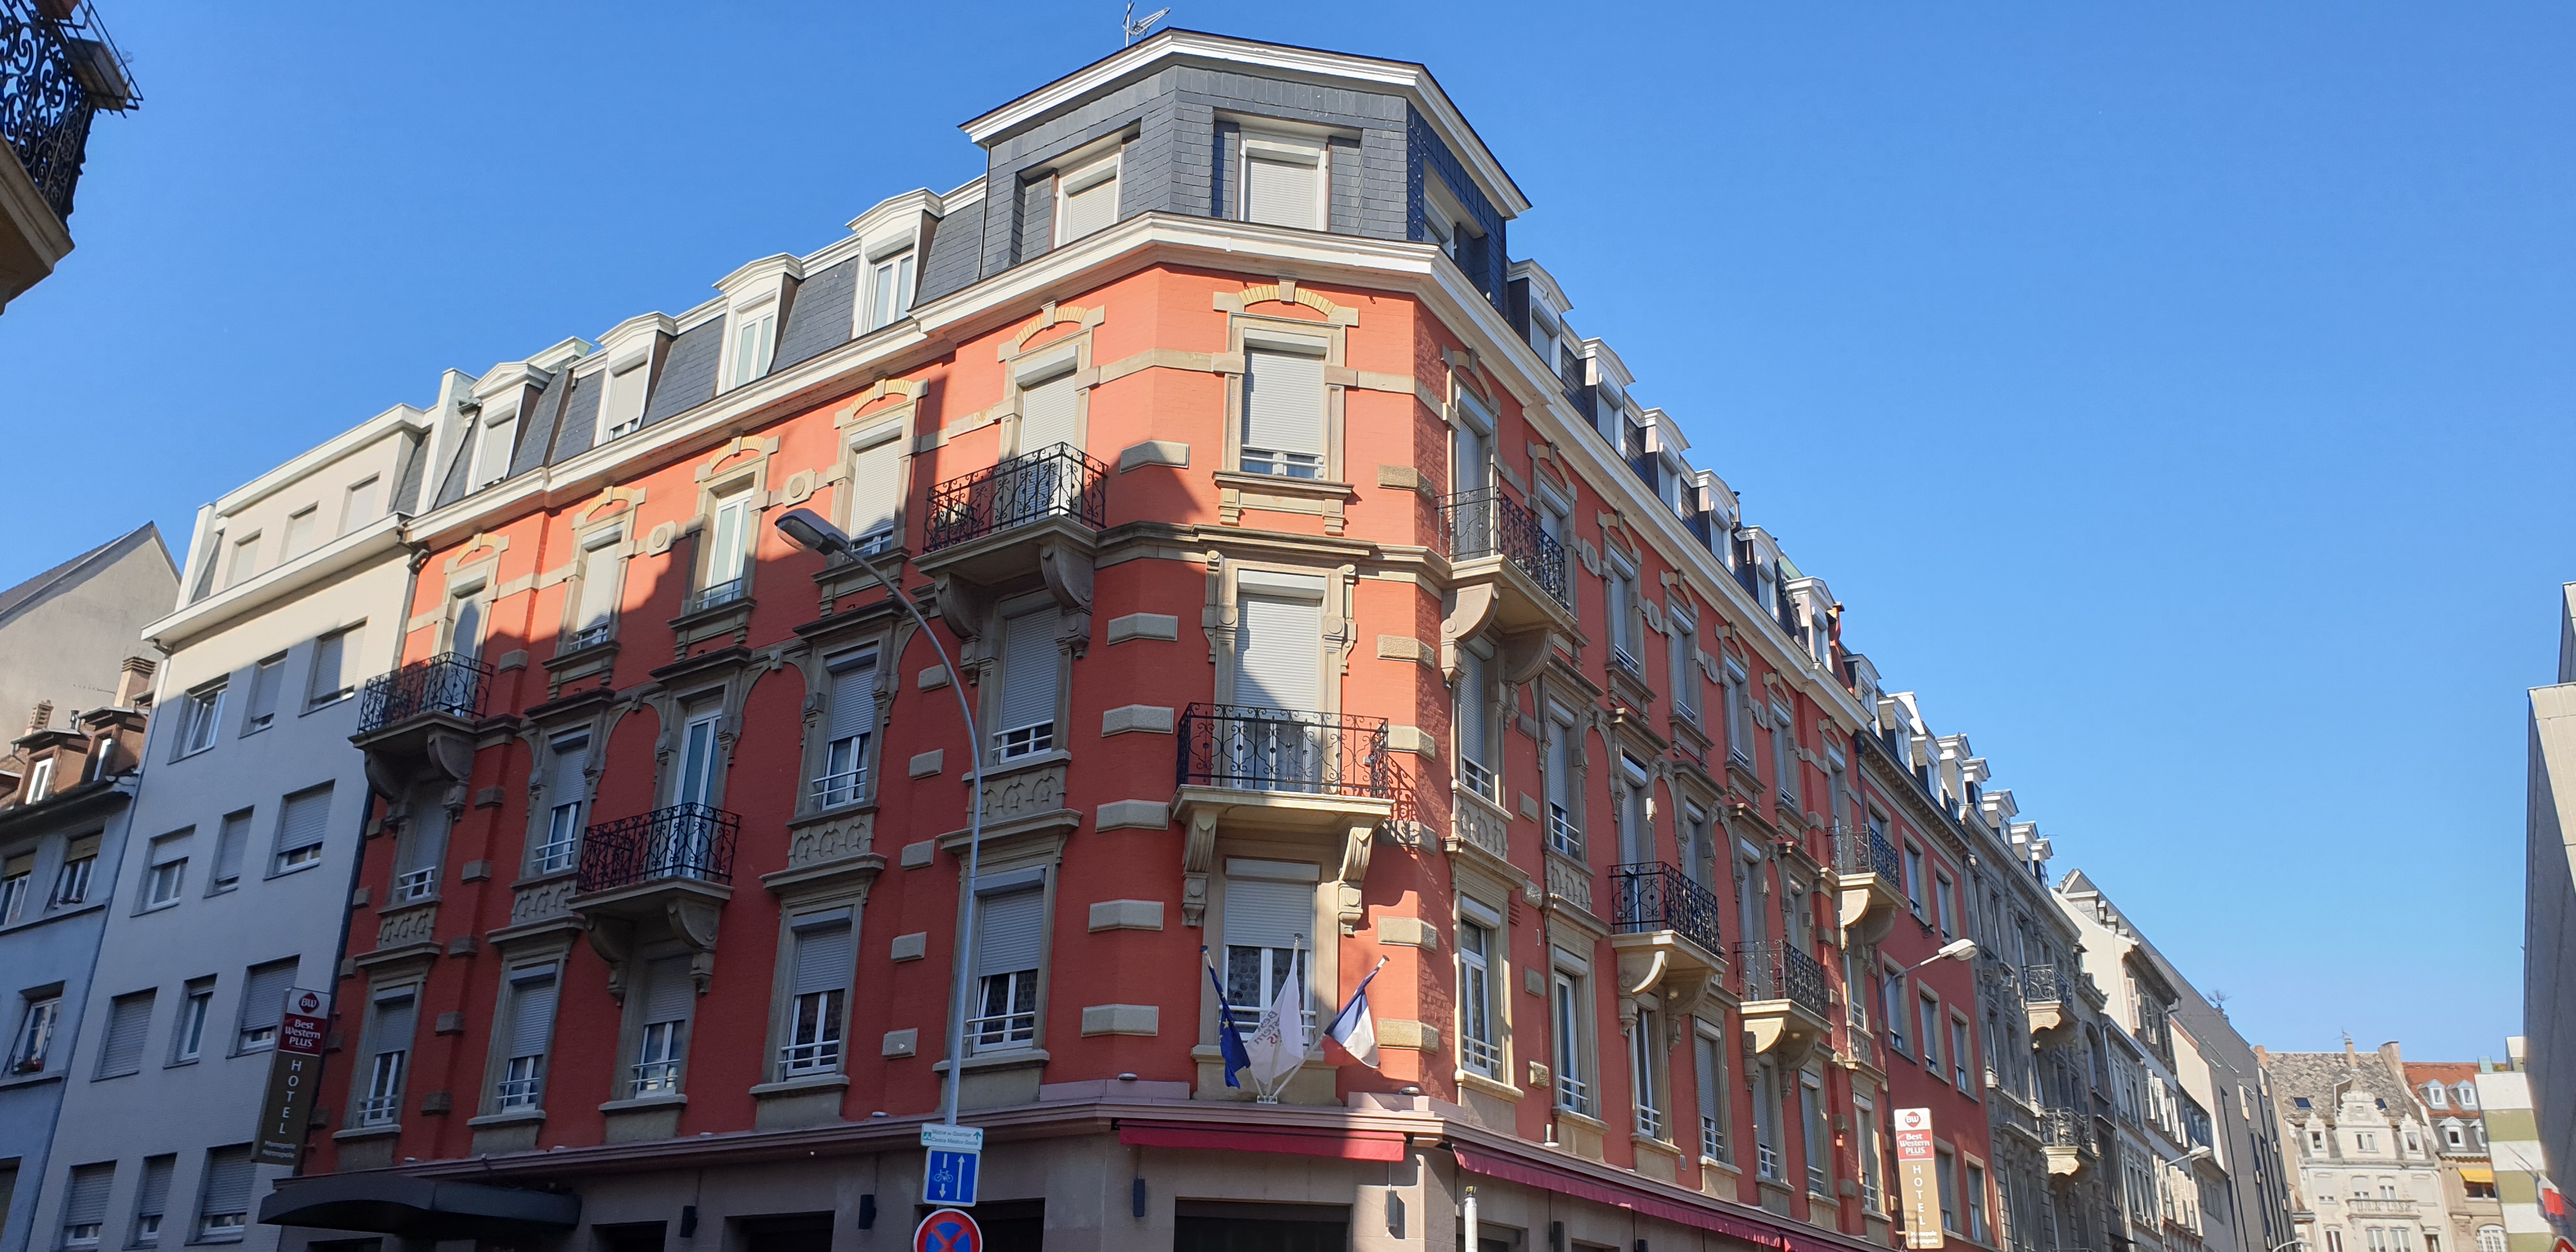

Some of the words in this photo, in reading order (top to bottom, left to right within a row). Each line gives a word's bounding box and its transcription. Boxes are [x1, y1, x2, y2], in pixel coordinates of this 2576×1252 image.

[301, 998, 317, 1008] BW
[294, 1019, 314, 1030] Best
[285, 1026, 321, 1039] Western
[289, 1036, 312, 1047] PLUS
[279, 1060, 302, 1134] HOTEL
[1912, 1165, 1926, 1226] HOTEL
